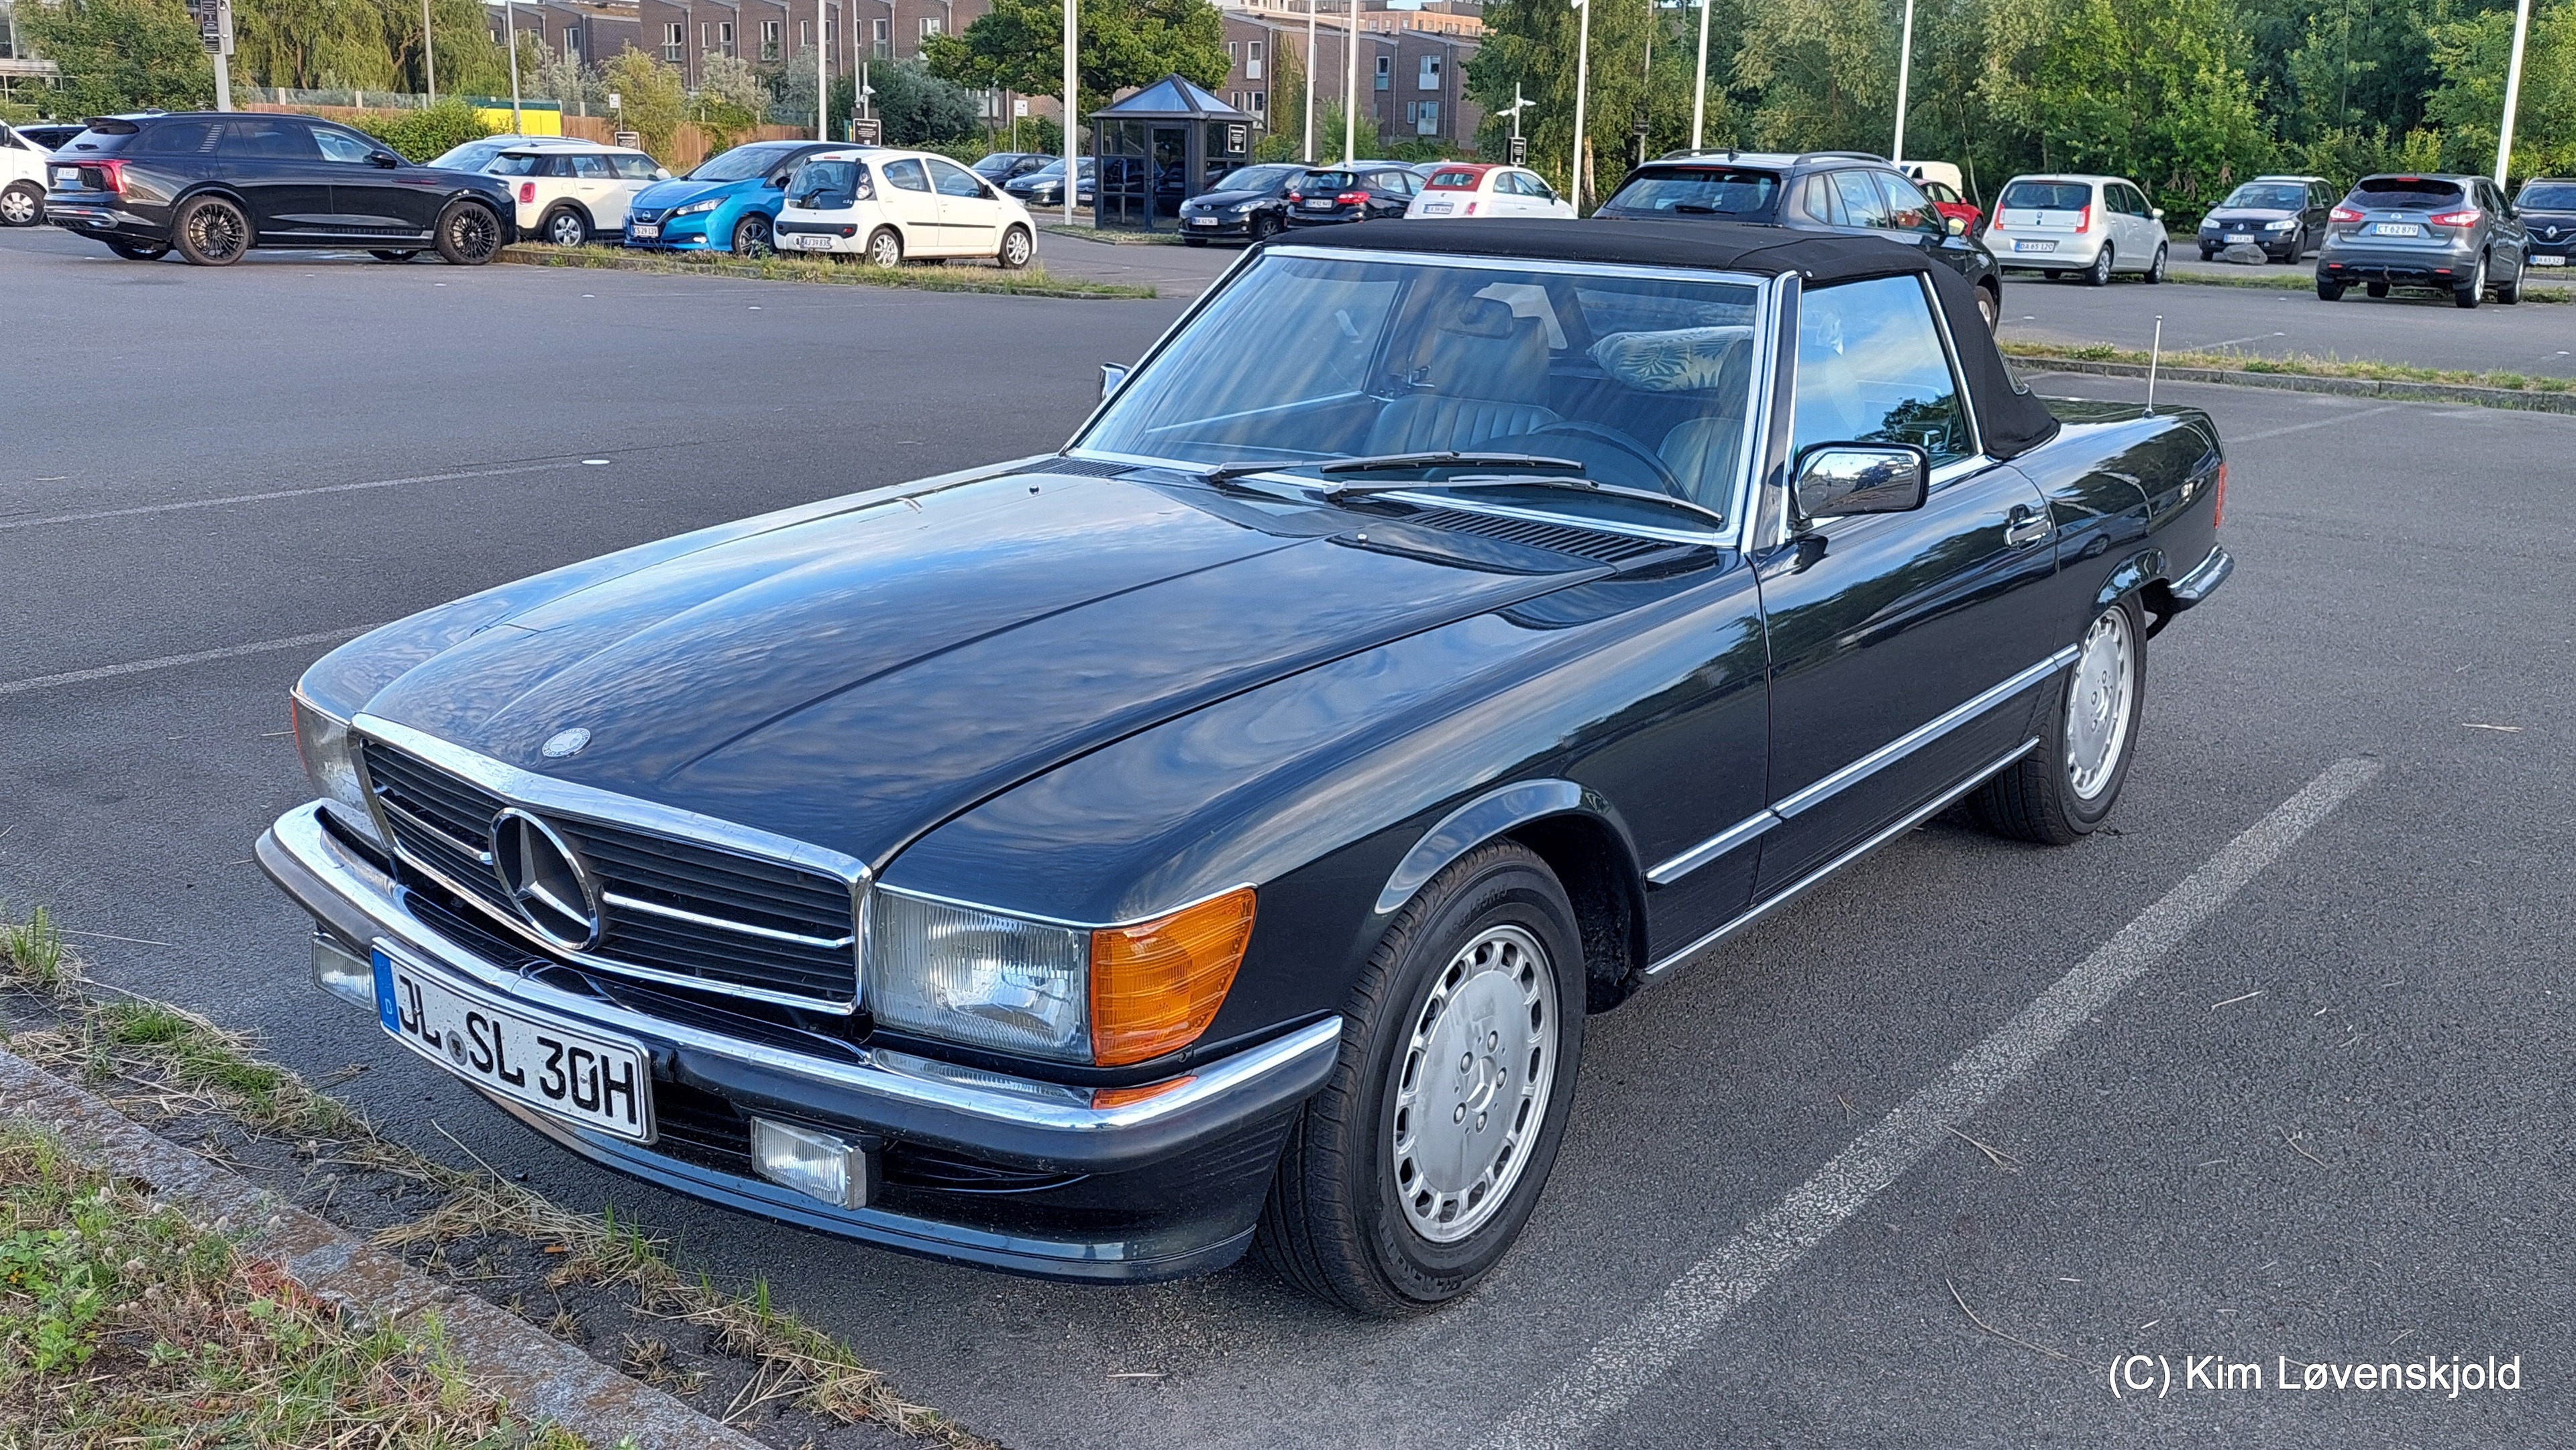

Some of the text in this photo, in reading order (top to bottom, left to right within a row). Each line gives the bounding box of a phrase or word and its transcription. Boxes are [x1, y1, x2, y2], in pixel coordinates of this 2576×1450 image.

[385, 998, 392, 1015] D
[466, 1011, 525, 1088] SL
[537, 1036, 637, 1125] 30H
